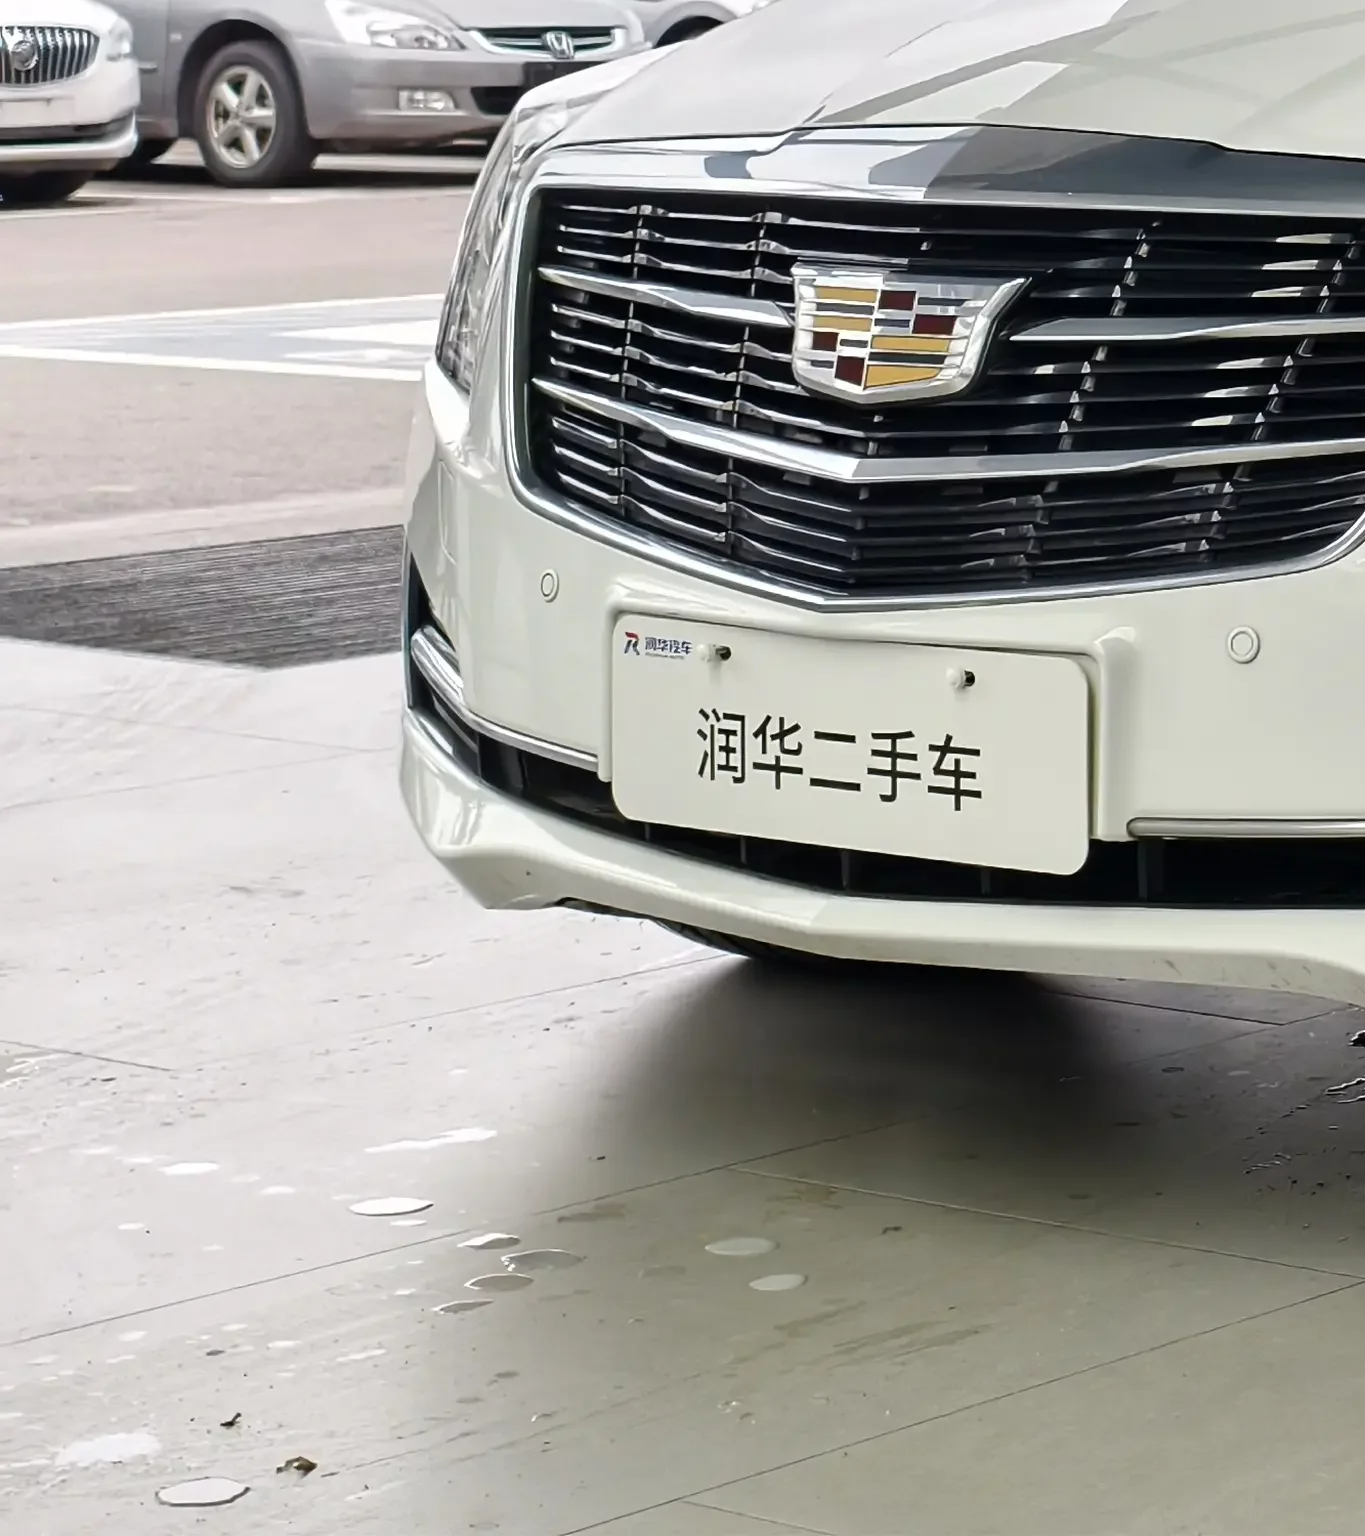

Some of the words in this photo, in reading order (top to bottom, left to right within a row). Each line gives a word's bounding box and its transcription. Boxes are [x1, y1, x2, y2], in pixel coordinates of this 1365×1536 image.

[697, 708, 982, 812] 润华二手车
